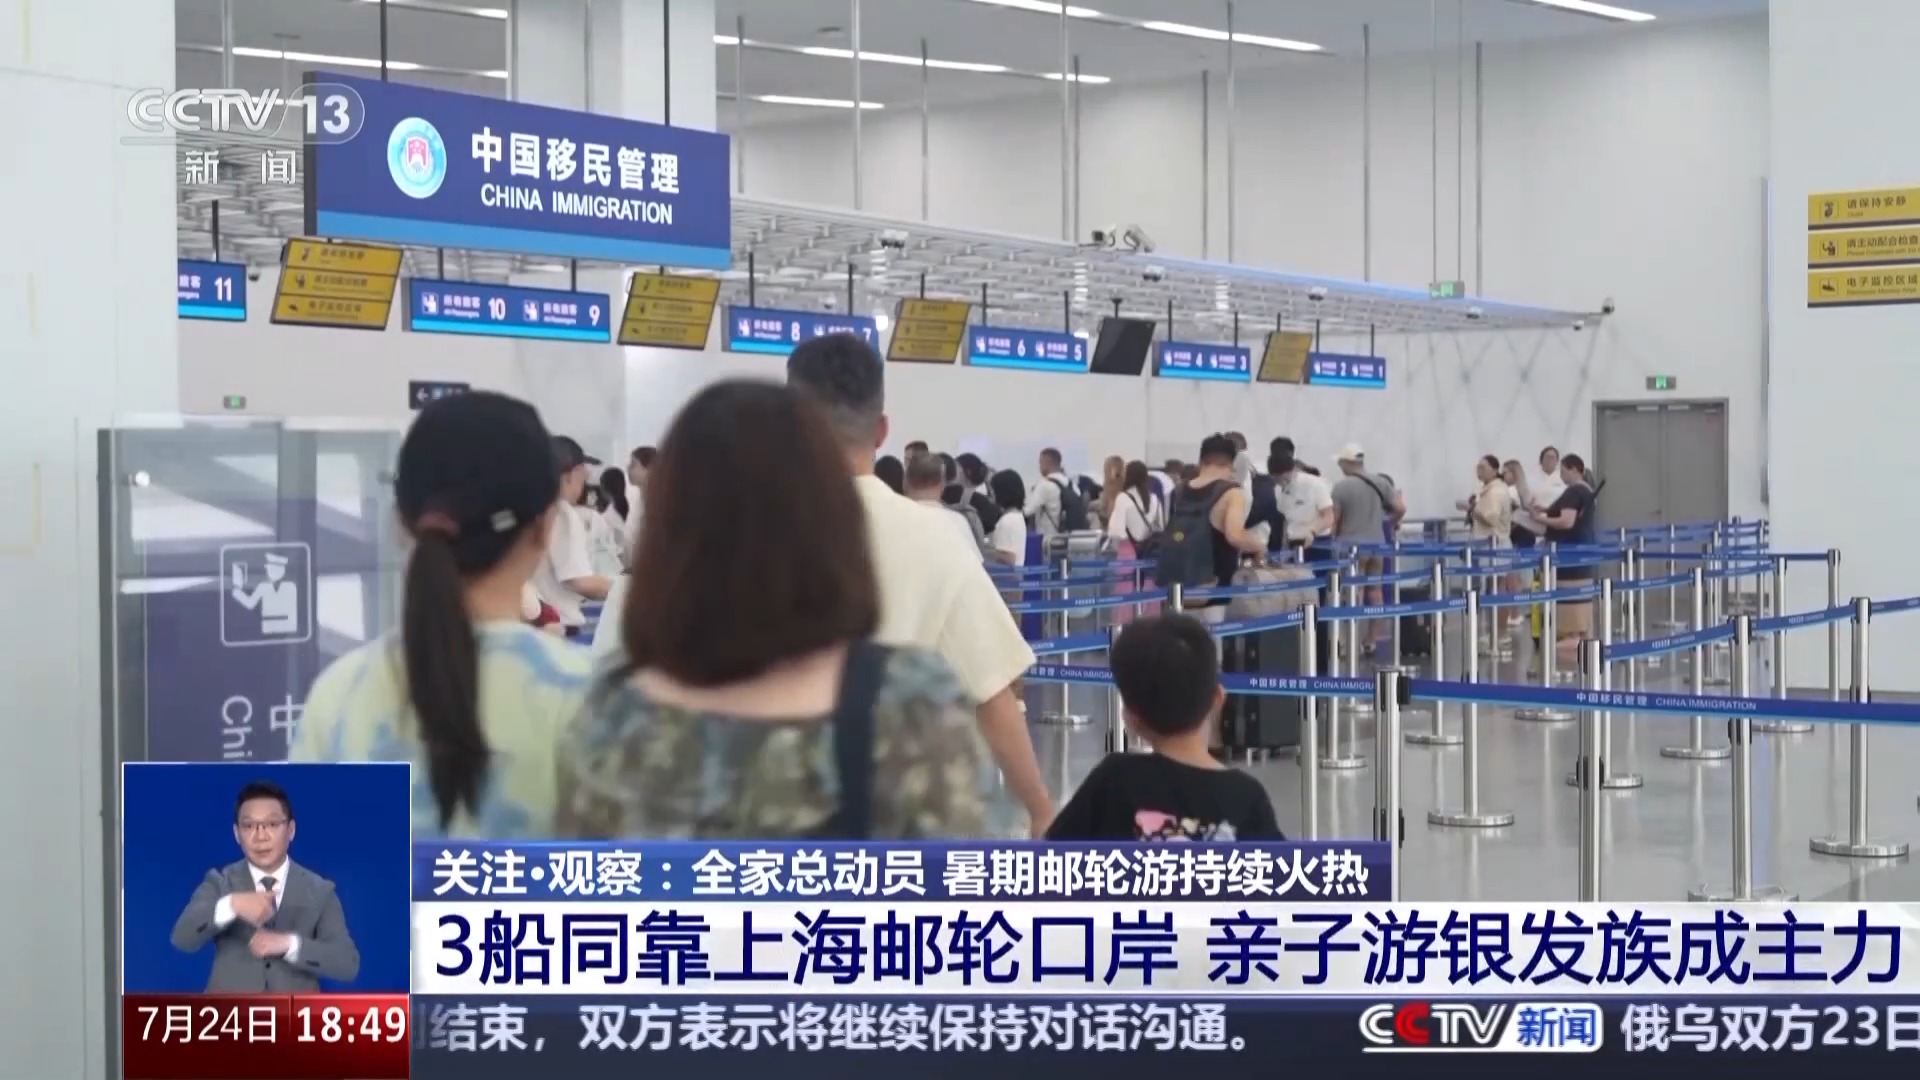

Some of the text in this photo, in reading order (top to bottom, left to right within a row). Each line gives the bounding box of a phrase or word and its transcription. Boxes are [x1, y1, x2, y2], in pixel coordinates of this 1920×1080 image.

[472, 127, 679, 194] 中国移民管理
[481, 183, 673, 225] CHINA IMMIGRATION
[213, 277, 232, 301] 11
[488, 298, 506, 320] 10
[588, 304, 600, 326] 9
[790, 321, 801, 342] 8
[862, 327, 872, 342] 7
[1017, 339, 1026, 357] 6
[1074, 344, 1082, 361] 5
[1060, 669, 1082, 678] CHINA
[1249, 677, 1308, 690] 中国移民管理
[1313, 680, 1339, 689] CHINA
[1576, 692, 1757, 711] 中国移民管理 CHINA IMMIGRATION
